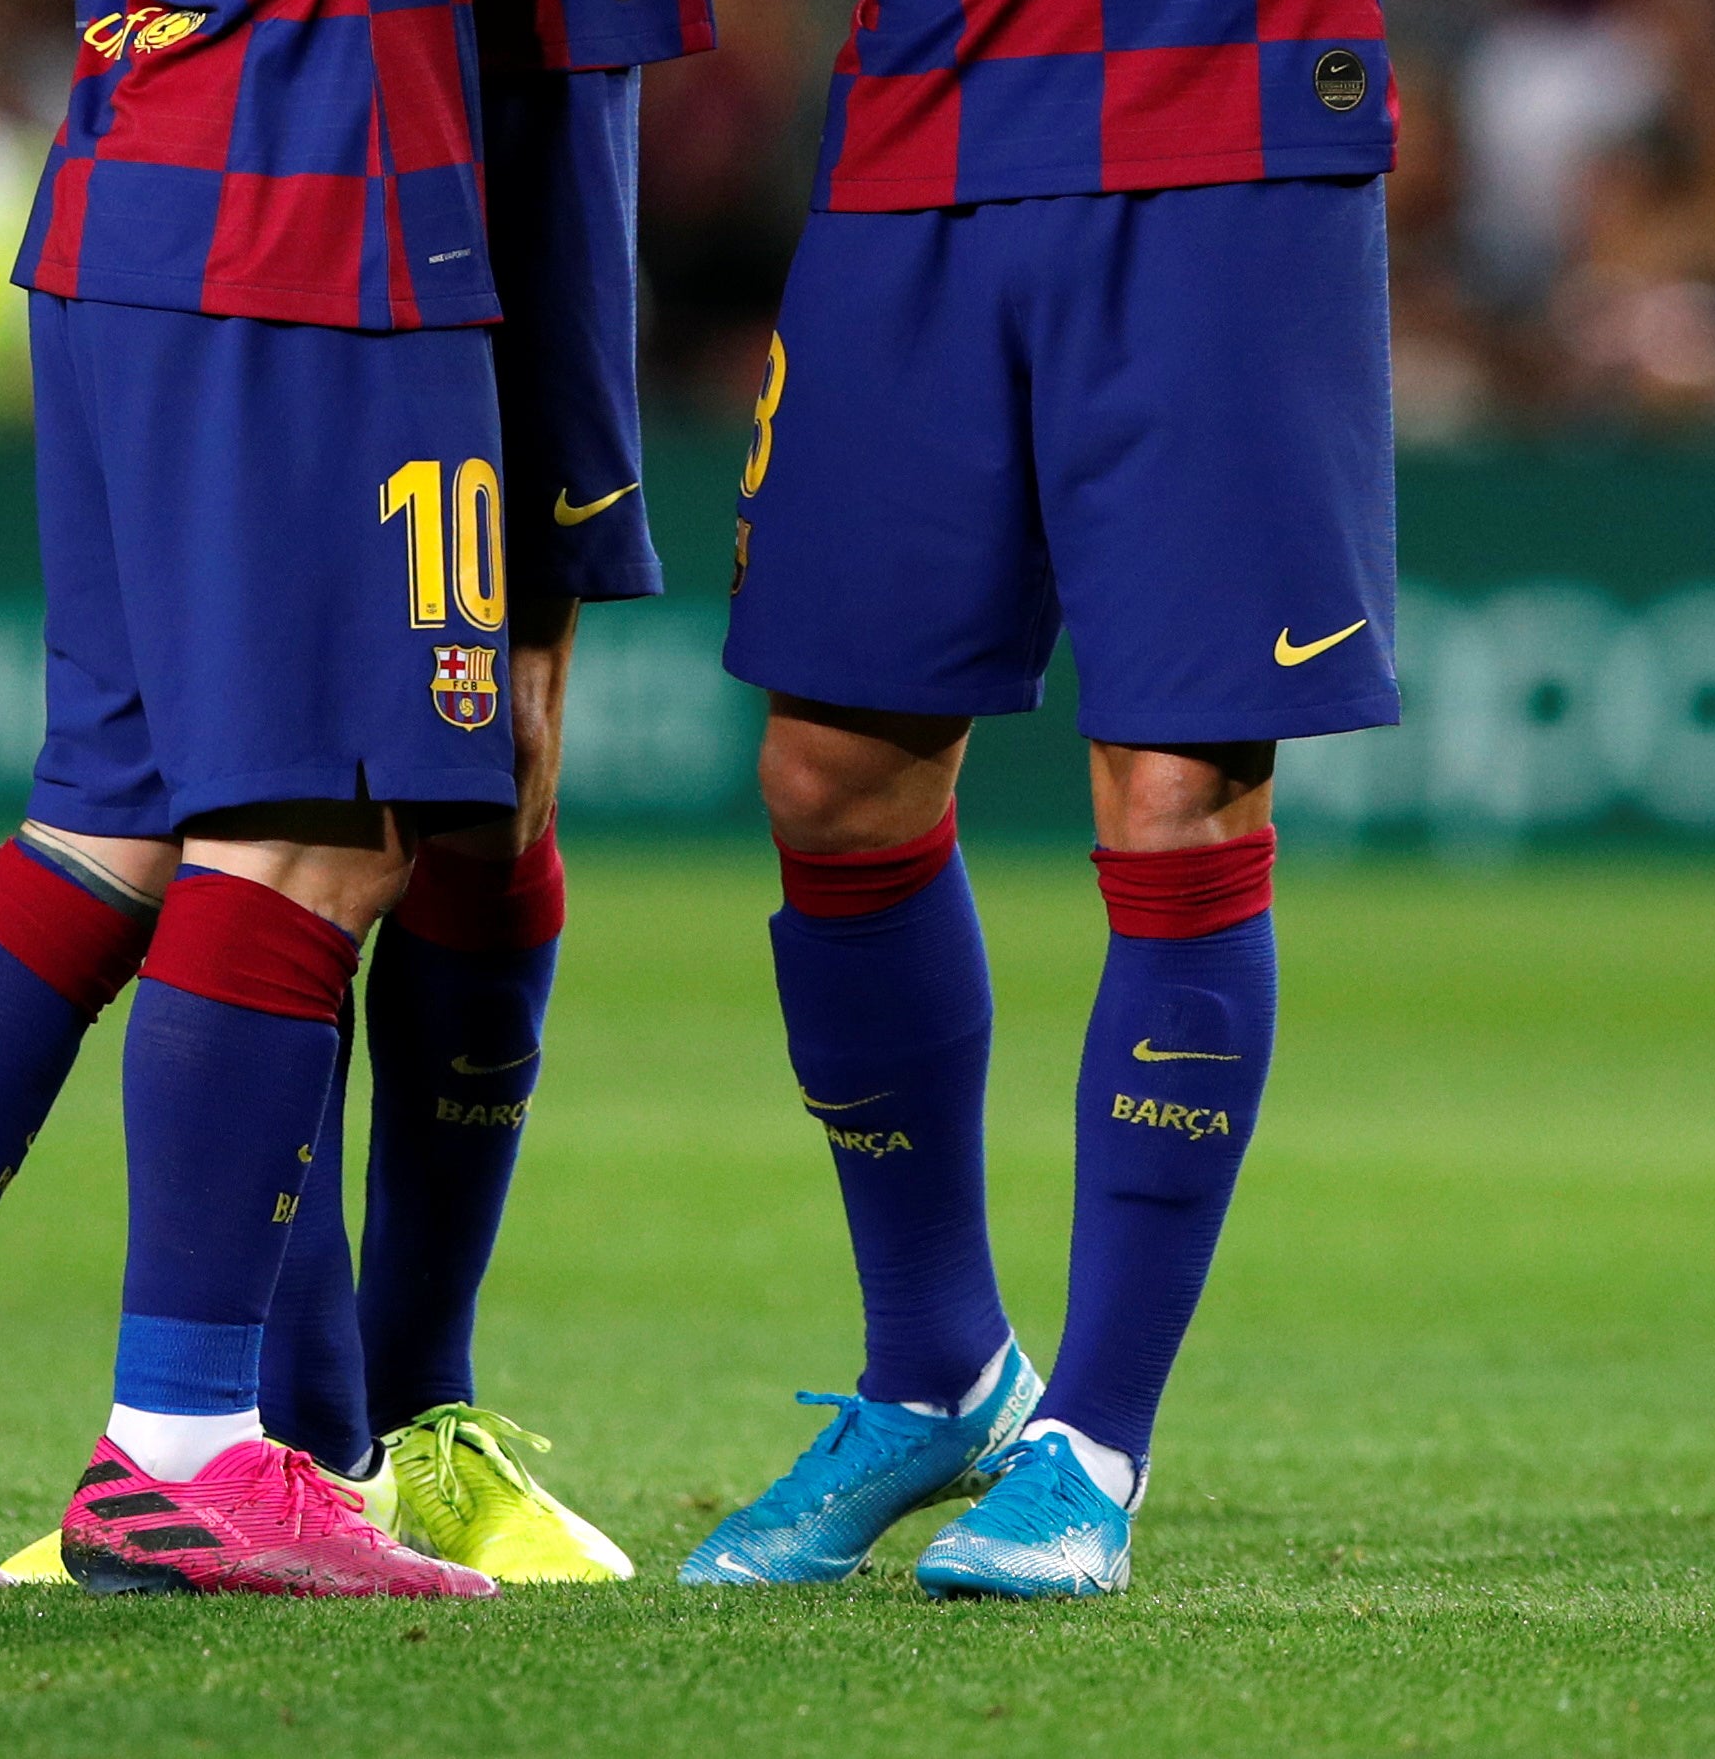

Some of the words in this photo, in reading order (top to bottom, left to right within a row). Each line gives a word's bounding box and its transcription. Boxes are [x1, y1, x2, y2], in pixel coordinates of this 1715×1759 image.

[379, 457, 506, 633] 10
[452, 681, 478, 692] FCB
[436, 1096, 532, 1131] BARÇ
[1111, 1093, 1230, 1141] BARÇA
[828, 1125, 914, 1159] ARÇA
